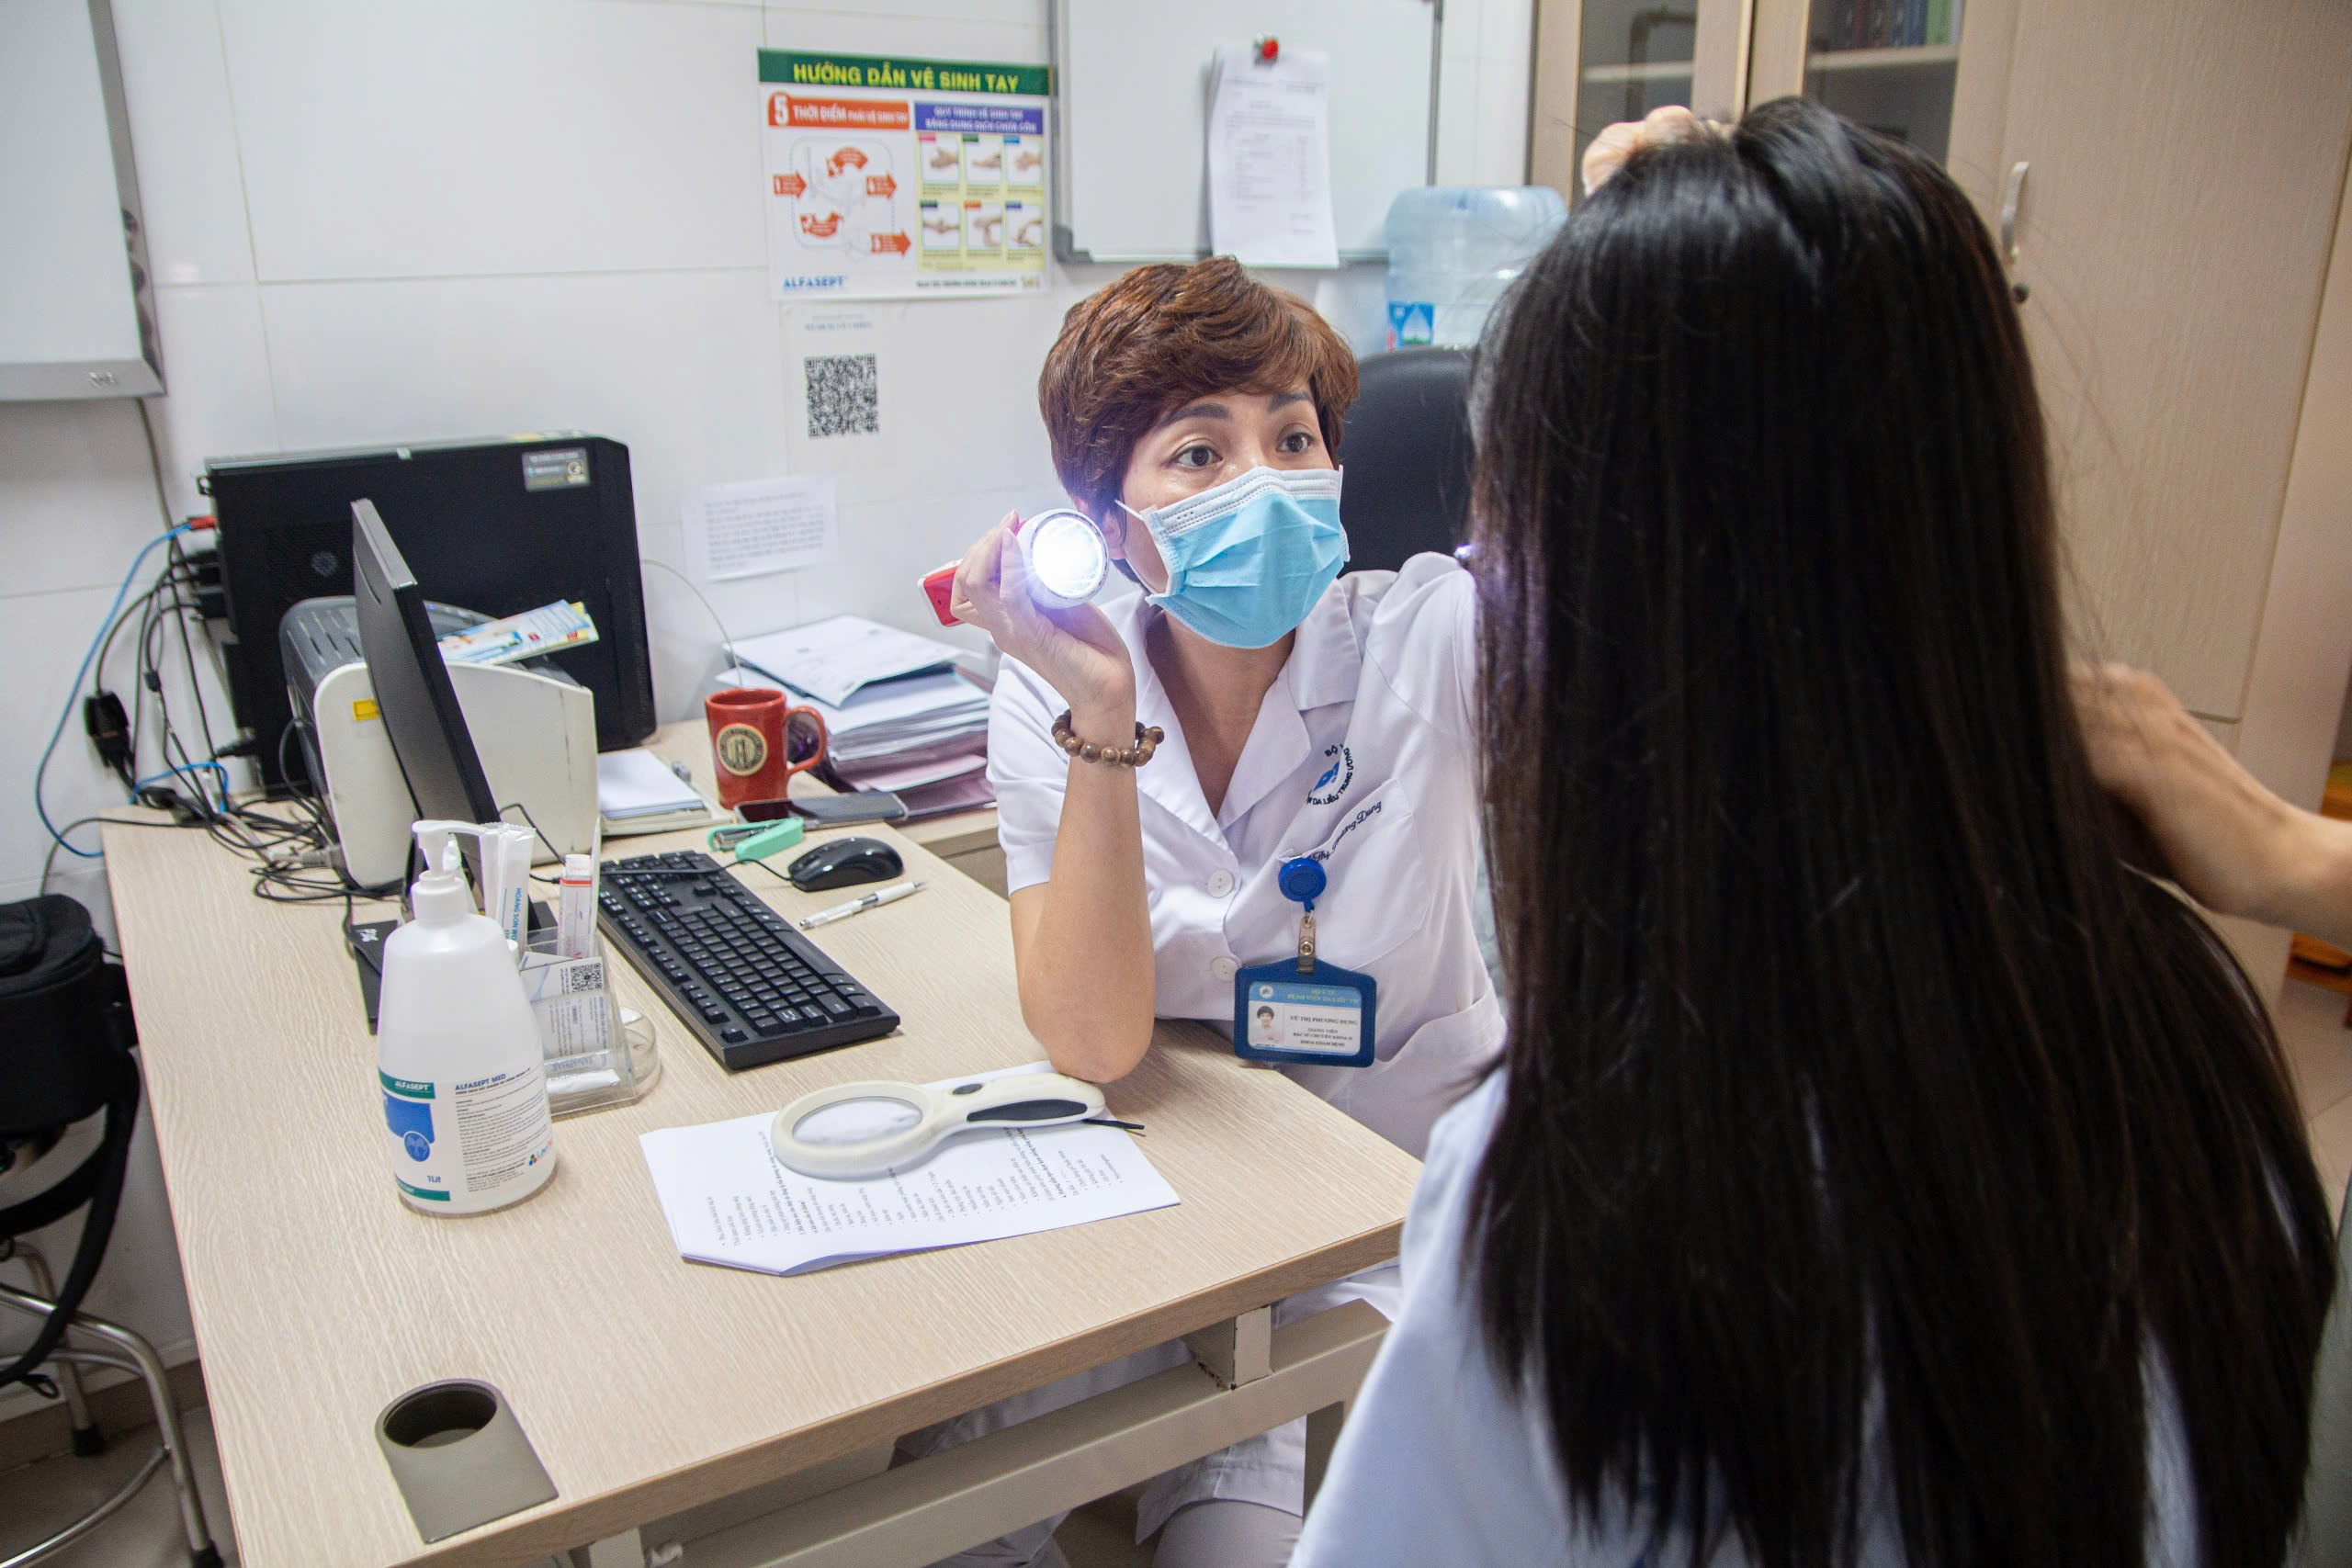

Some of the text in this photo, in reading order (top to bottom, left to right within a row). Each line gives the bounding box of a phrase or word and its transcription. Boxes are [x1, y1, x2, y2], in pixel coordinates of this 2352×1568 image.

[793, 61, 1019, 93] HƯỚNG DẪN VỆ SINH TAY
[774, 95, 789, 126] 5
[783, 276, 844, 288] ALFASEPT
[1356, 801, 1382, 824] Dung
[455, 1073, 506, 1091] ALFASEPT MED
